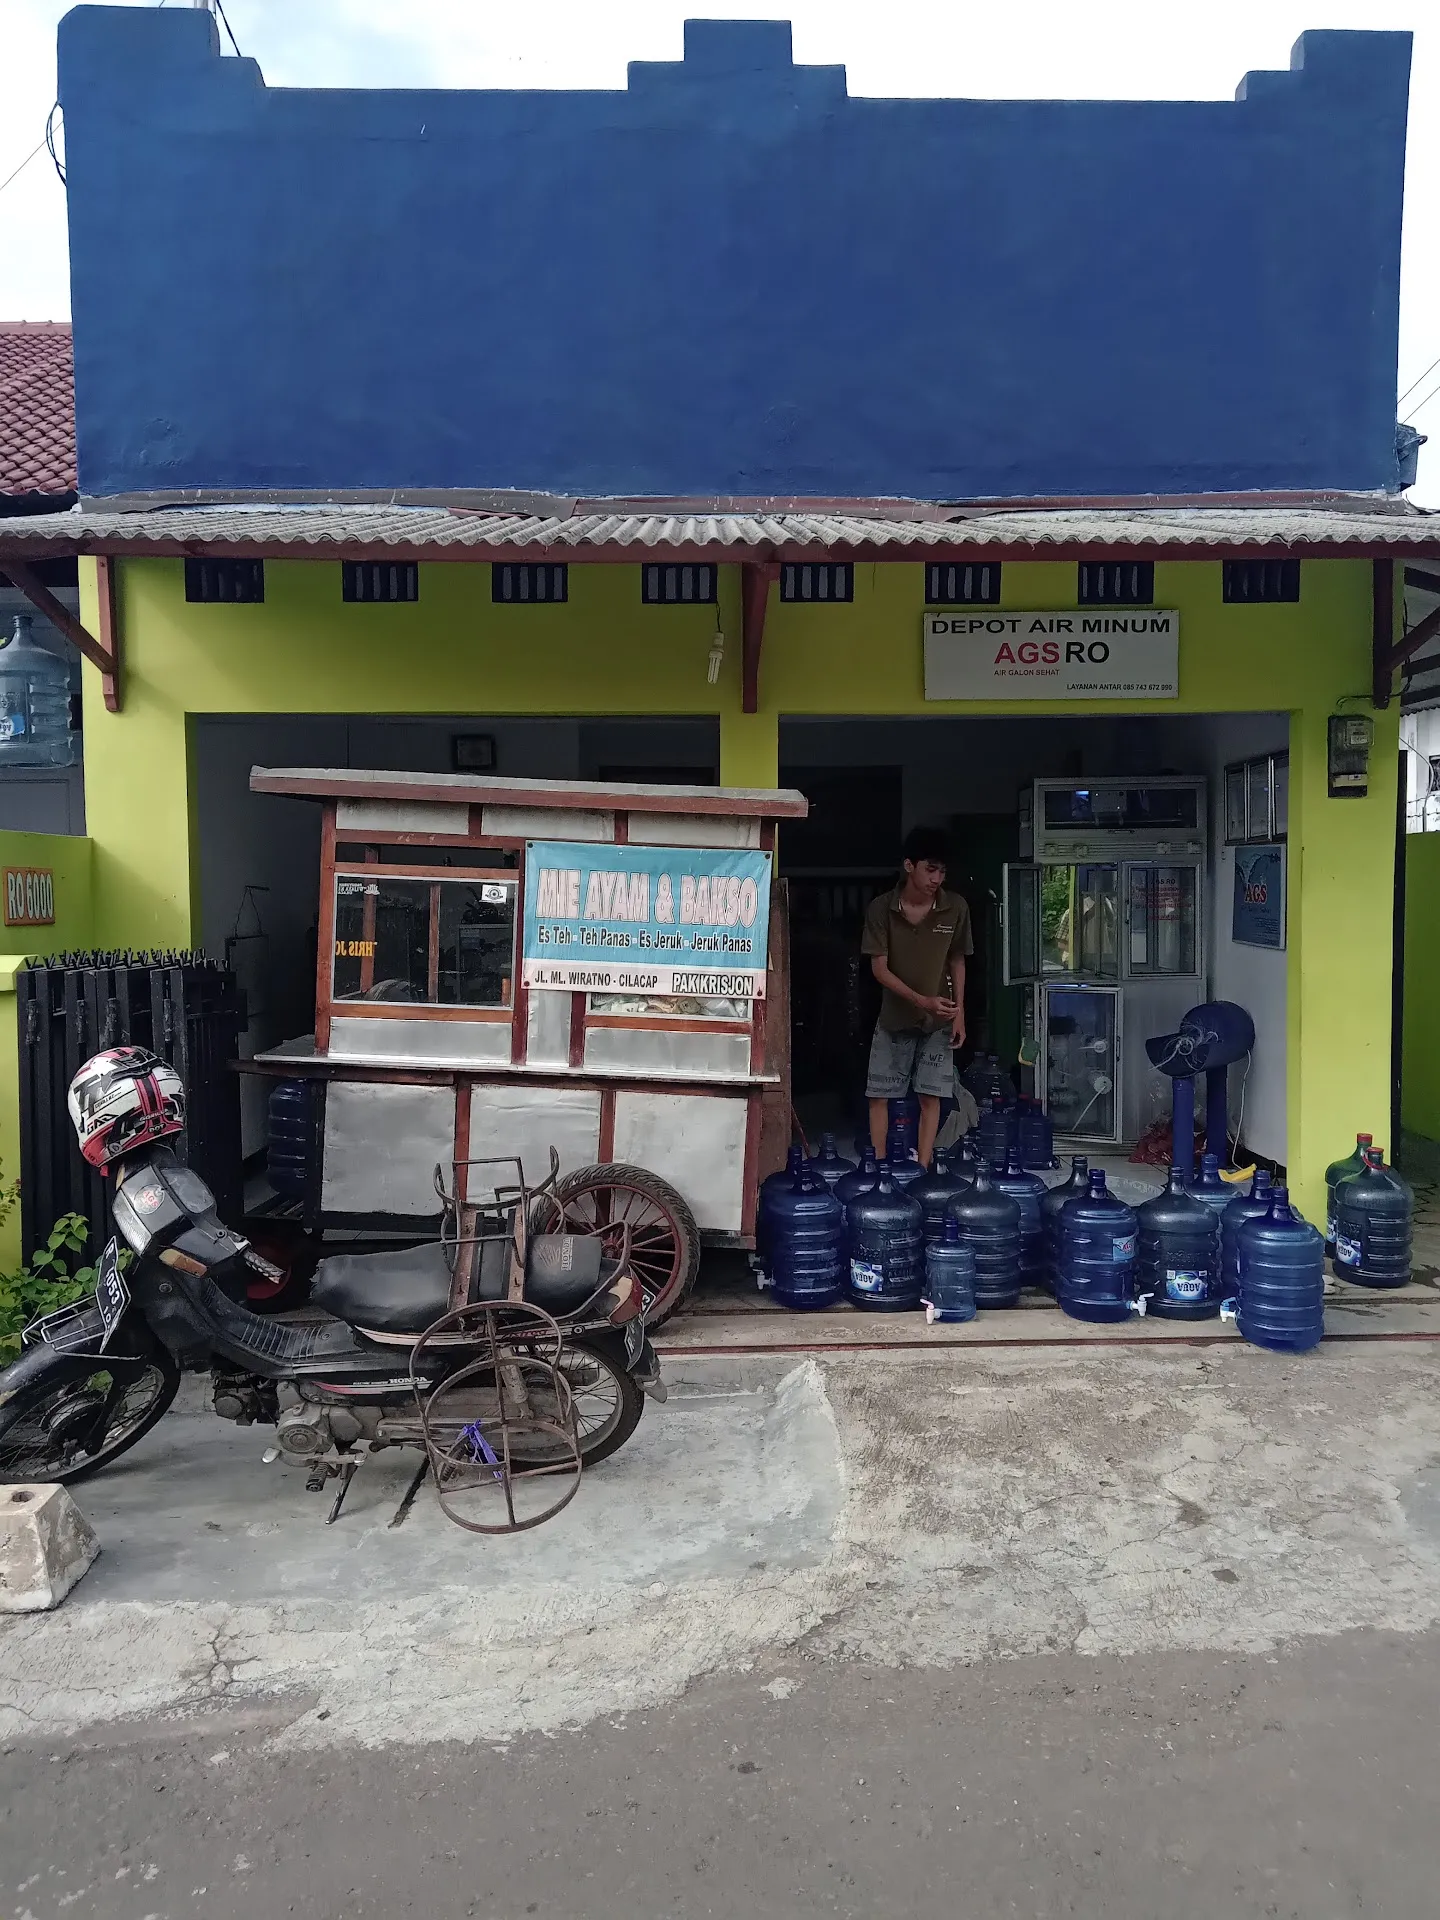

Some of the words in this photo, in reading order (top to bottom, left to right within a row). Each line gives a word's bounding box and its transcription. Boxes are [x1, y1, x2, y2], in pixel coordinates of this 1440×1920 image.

[932, 619, 1021, 634] DEPOT
[1028, 619, 1073, 633] AIR
[1082, 618, 1170, 633] MINUM
[994, 642, 1060, 664] AGS
[1066, 641, 1110, 664] RO
[1008, 669, 1034, 677] GALON
[1036, 669, 1060, 677] SEHAT
[1067, 683, 1098, 691] LAYANAN
[1099, 683, 1122, 691] ANTAR
[8, 871, 25, 919] RO
[26, 872, 53, 919] 6000
[536, 868, 581, 920] MIE
[584, 870, 650, 923] AYAM
[654, 873, 675, 924] &
[680, 874, 757, 928] BAKSO
[1244, 883, 1267, 904] AGS
[538, 926, 550, 944] Es
[553, 926, 571, 945] Teh
[580, 928, 597, 946] Teh
[600, 928, 630, 947] Panas
[639, 930, 651, 947] Es
[654, 931, 682, 950] Jeruk
[690, 932, 719, 952] Jeruk
[722, 934, 751, 953] Panas
[535, 970, 548, 983] JL.
[551, 972, 566, 984] ML.
[569, 972, 611, 987] WIRATNO
[619, 974, 658, 988] CILACAP
[672, 972, 698, 993] PAK
[699, 975, 754, 996] KRISJON
[149, 1124, 166, 1133] DOT
[106, 1243, 114, 1259] R
[855, 1272, 874, 1284] AQUA
[1177, 1282, 1200, 1292] AQUA
